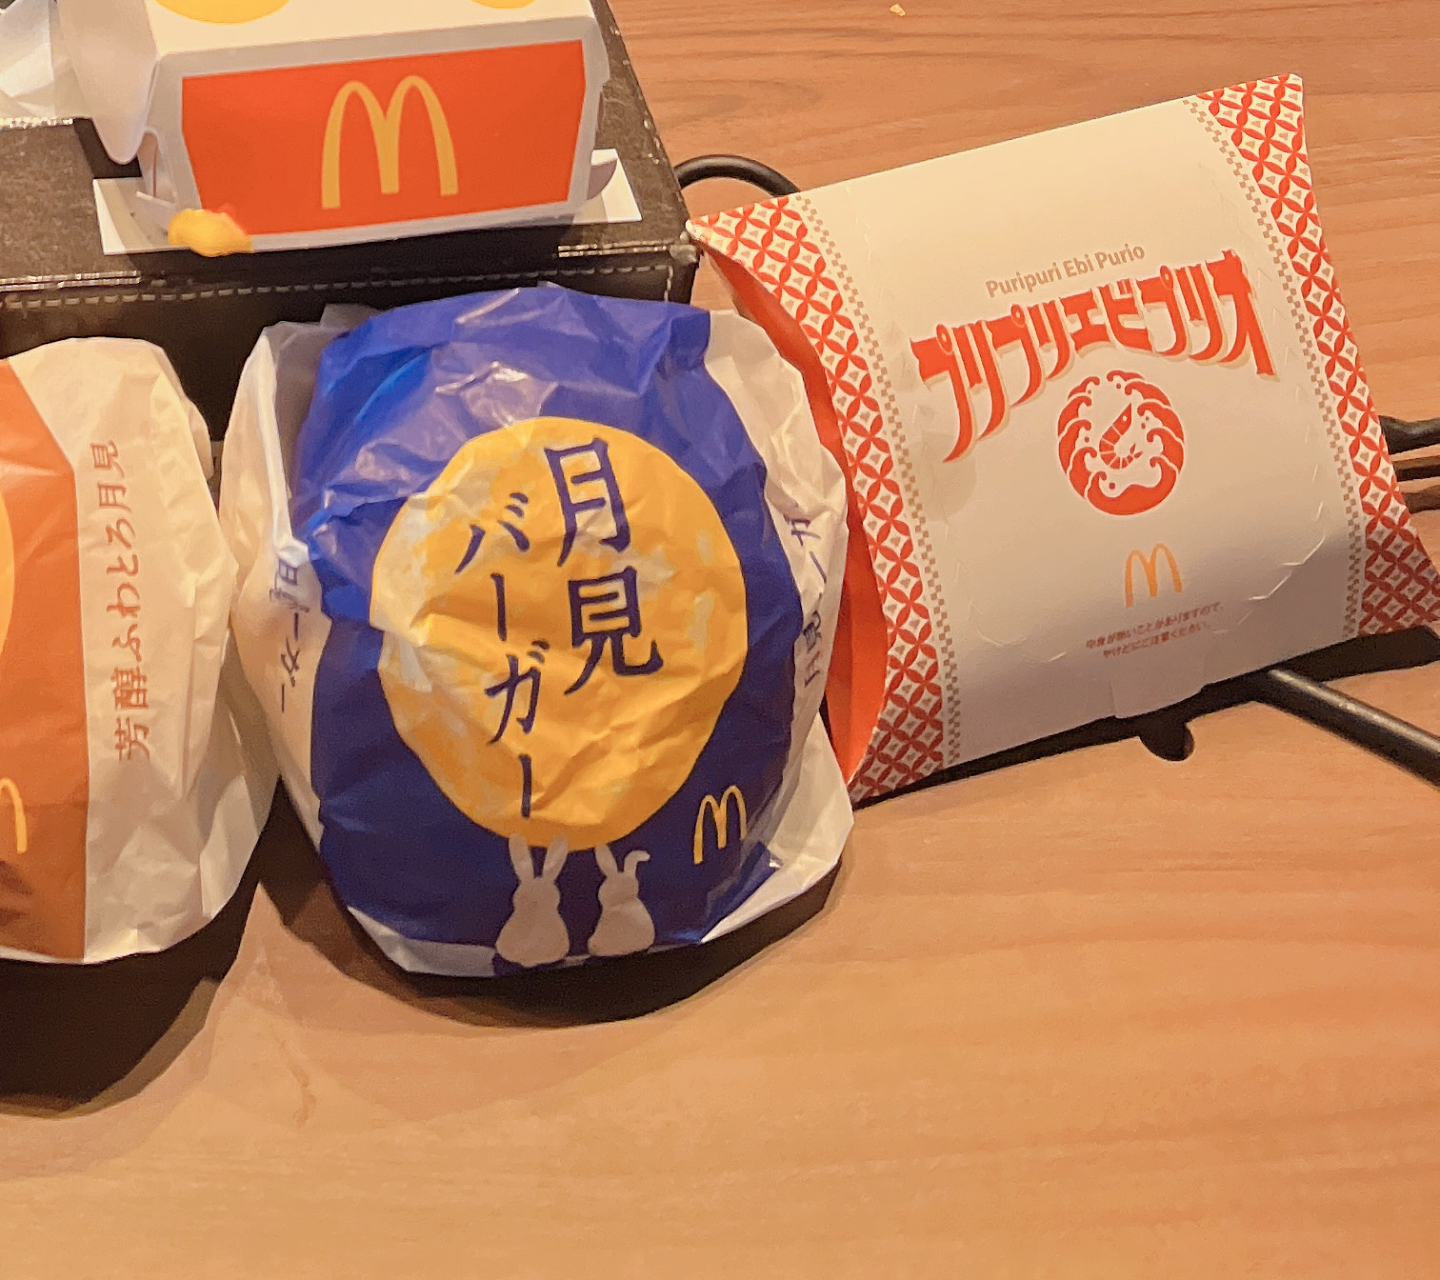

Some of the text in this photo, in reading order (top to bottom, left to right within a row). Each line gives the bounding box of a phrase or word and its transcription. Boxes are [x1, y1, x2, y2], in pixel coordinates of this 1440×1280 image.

[986, 244, 1146, 297] Puripuri Ebi Purio
[88, 439, 151, 762] 芳醇ふわとろ月見
[455, 492, 550, 819] バーガー
[544, 437, 664, 696] 月見
